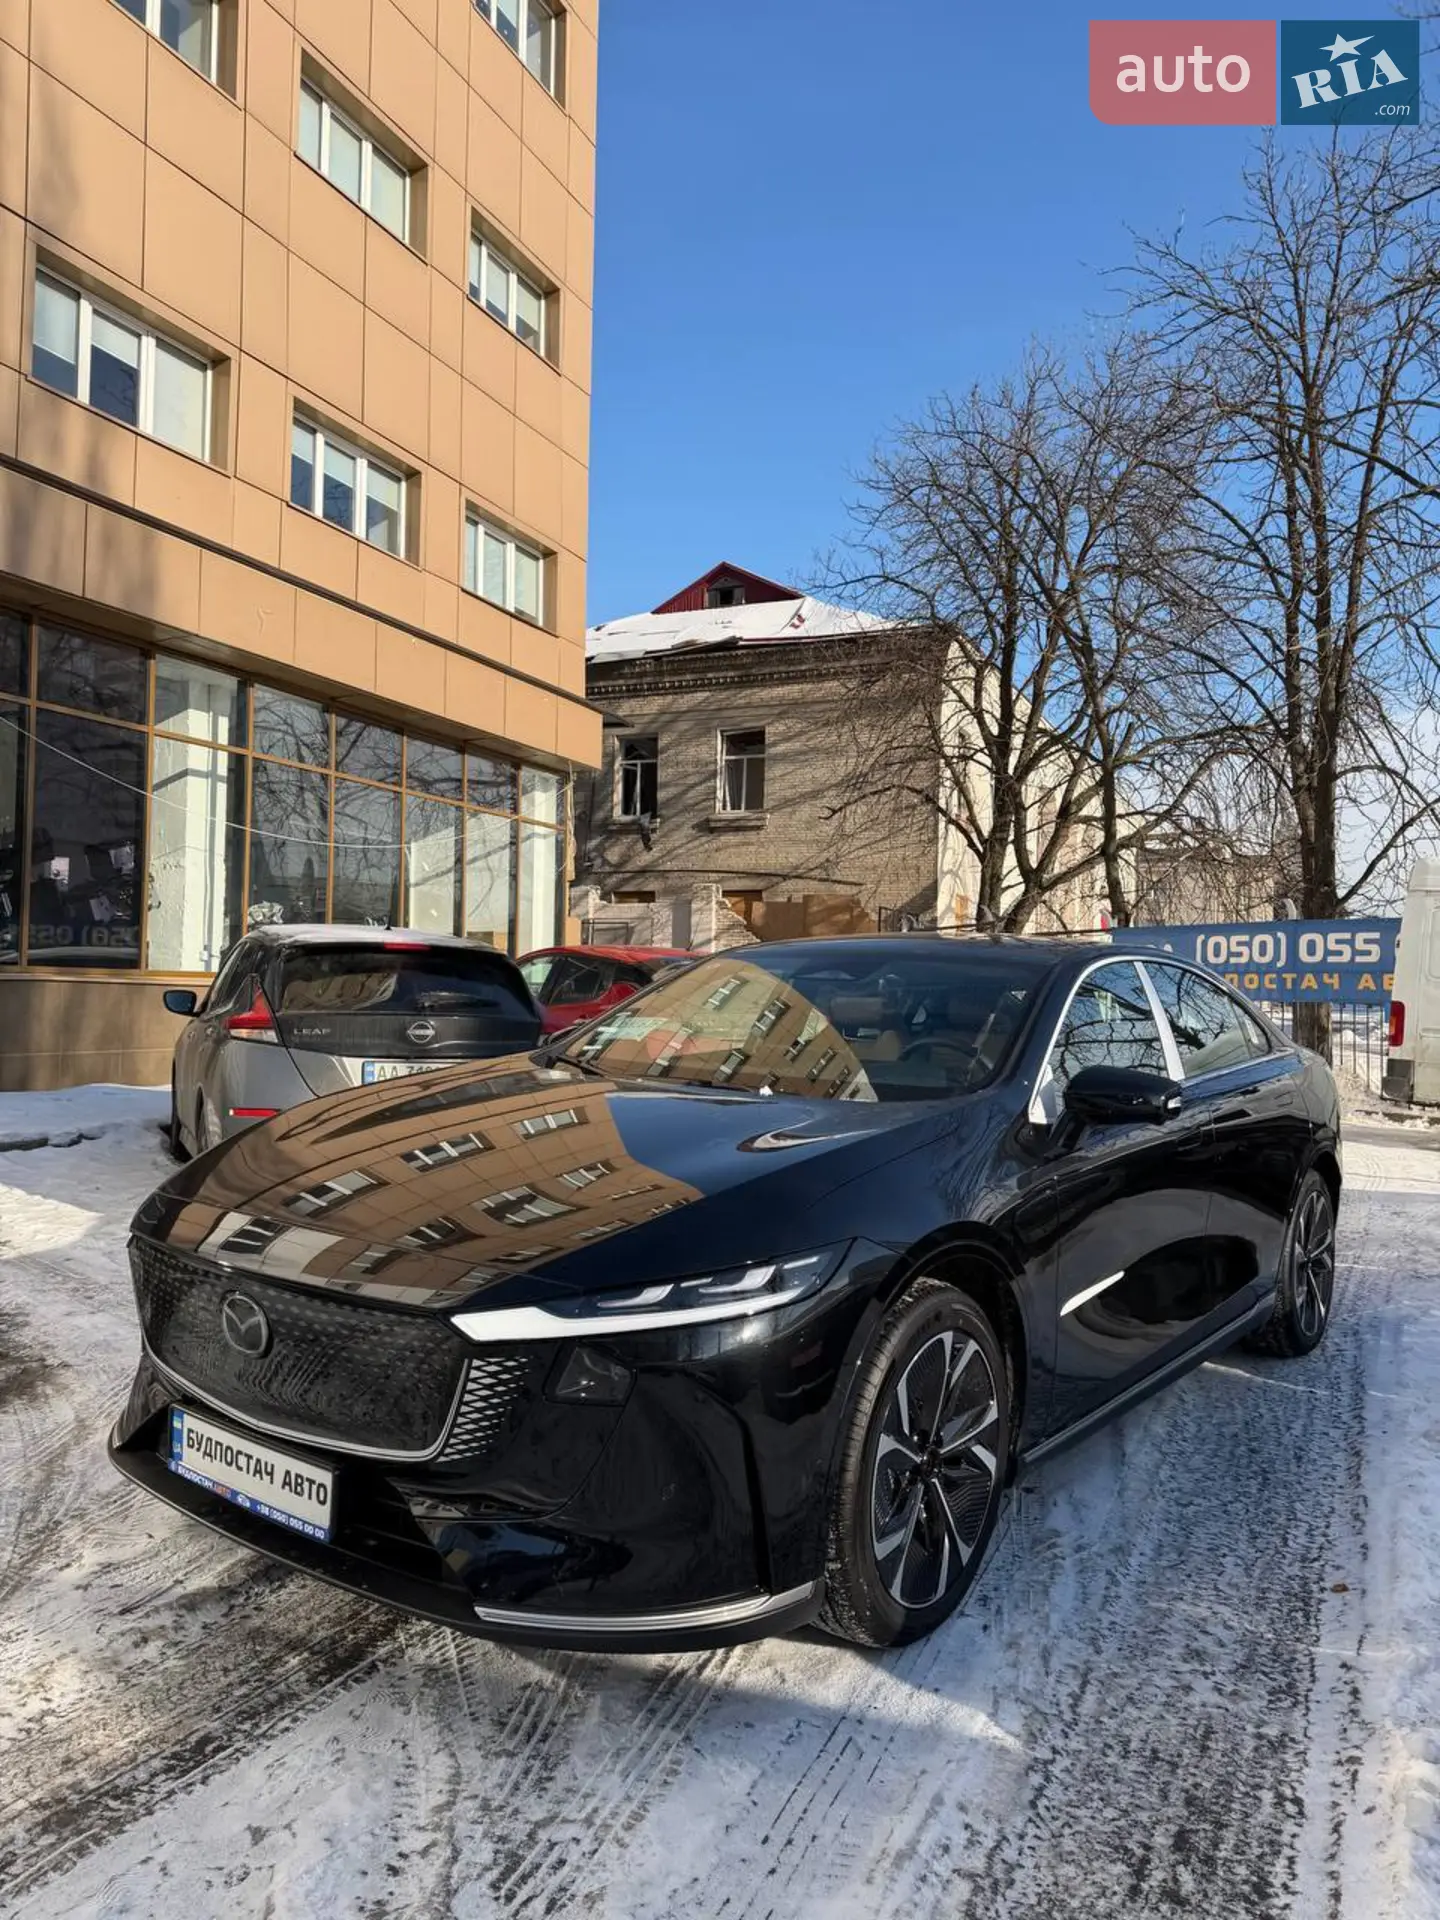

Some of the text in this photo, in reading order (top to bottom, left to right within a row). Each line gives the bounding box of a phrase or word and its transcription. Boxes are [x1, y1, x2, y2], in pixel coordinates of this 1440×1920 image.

[1195, 932, 1381, 968] (050) 055
[186, 1427, 328, 1506] БУДПОСТАЧ АВТО
